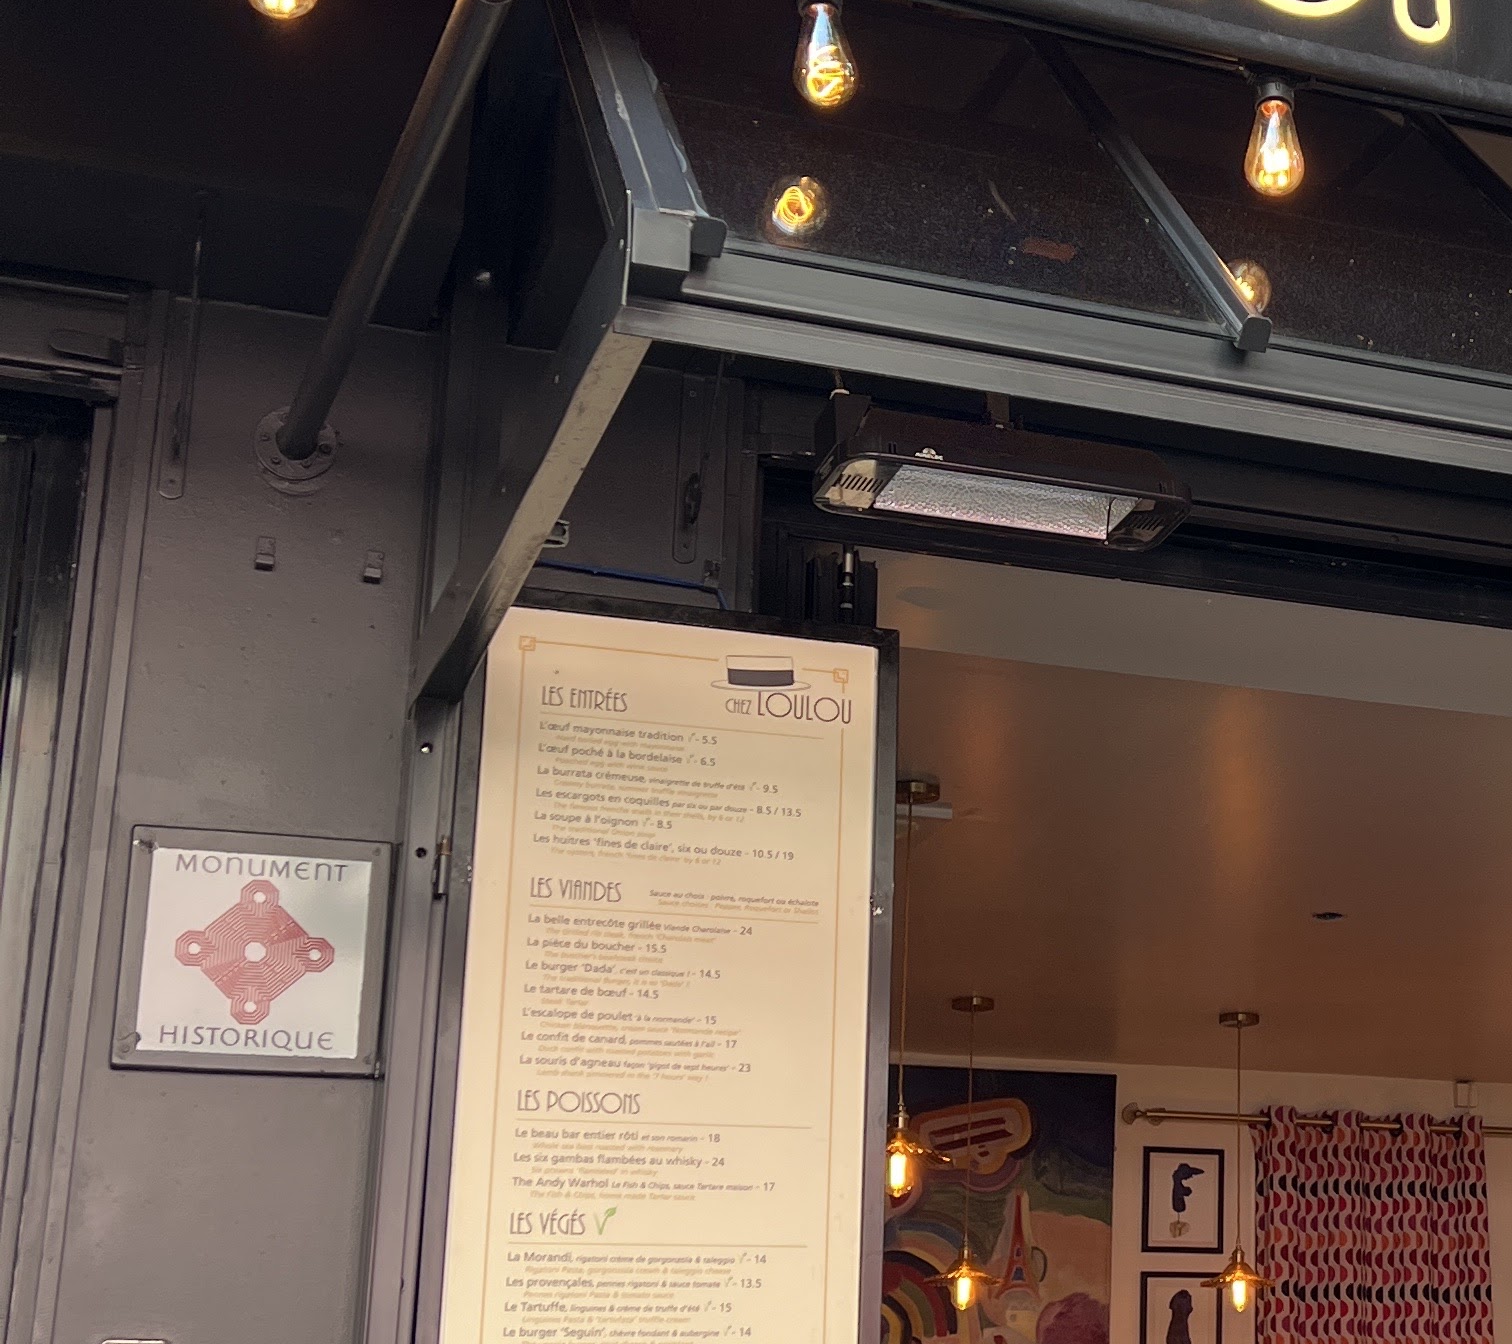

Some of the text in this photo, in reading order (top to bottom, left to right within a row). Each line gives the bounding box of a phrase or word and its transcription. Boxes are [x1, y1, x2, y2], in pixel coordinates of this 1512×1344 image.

[541, 685, 627, 712] LES ENTRÉES
[725, 690, 852, 724] CHEZ LOULOU
[572, 725, 635, 737] mayonnaise
[638, 730, 683, 741] tradition
[701, 735, 717, 745] 5.5
[571, 746, 604, 757] poché
[615, 749, 625, 758] la
[628, 750, 682, 763] bordelaise
[700, 756, 715, 766] 6.5
[536, 765, 549, 774] La
[552, 766, 592, 778] burrata
[762, 784, 778, 793] 9.5
[535, 787, 552, 797] Les
[555, 791, 605, 802] escargots
[623, 796, 669, 807] coquilles
[756, 805, 771, 815] 8.5
[781, 807, 801, 817] 13.5
[533, 810, 547, 820] La
[549, 813, 581, 823] soupe
[656, 819, 672, 829] 8.5
[532, 833, 550, 843] Les
[623, 839, 638, 849] de
[677, 843, 691, 853] six
[693, 846, 707, 854] ou
[709, 845, 742, 856] douze
[752, 848, 772, 858] 10.5
[782, 851, 794, 859] 19
[175, 853, 349, 883] MONUMENT
[530, 877, 621, 902] LES VIANDES
[527, 913, 752, 935] La belle entrecôte grillée 24
[526, 936, 539, 946] La
[541, 938, 571, 948] pièce
[573, 938, 588, 949] du
[591, 940, 635, 951] boucher
[645, 943, 666, 953] 15.5
[525, 959, 538, 969] Le
[540, 960, 578, 973] burger
[699, 969, 720, 979] 14.5
[523, 983, 536, 993] Le
[539, 984, 577, 995] tartare
[579, 985, 594, 996] de
[637, 989, 658, 999] 14.5
[579, 1009, 594, 1019] de
[596, 1011, 632, 1021] poulet
[704, 1015, 716, 1025] 15
[159, 1024, 335, 1051] HISTORIQUE
[520, 1030, 534, 1040] Le
[535, 1031, 568, 1041] confit
[571, 1032, 586, 1042] de
[725, 1039, 737, 1048] 17
[519, 1054, 532, 1064] La
[534, 1055, 567, 1065] souris
[738, 1062, 751, 1072] 23
[517, 1089, 639, 1114] LES POISSONS
[514, 1127, 720, 1143] Le beau bar entier rôti 18
[513, 1151, 724, 1168] Les six gambas flambées au whisky 24
[511, 1176, 775, 1191] The Andy Warhol 17
[509, 1208, 585, 1235] LES VÉGÉS
[506, 1251, 520, 1262] La
[754, 1254, 766, 1263] 14
[505, 1276, 523, 1287] Les
[740, 1278, 761, 1288] 13.5
[504, 1301, 517, 1311] Le
[719, 1302, 732, 1312] 15
[502, 1326, 516, 1337] Le
[518, 1326, 557, 1339] burger
[739, 1326, 751, 1336] 14
